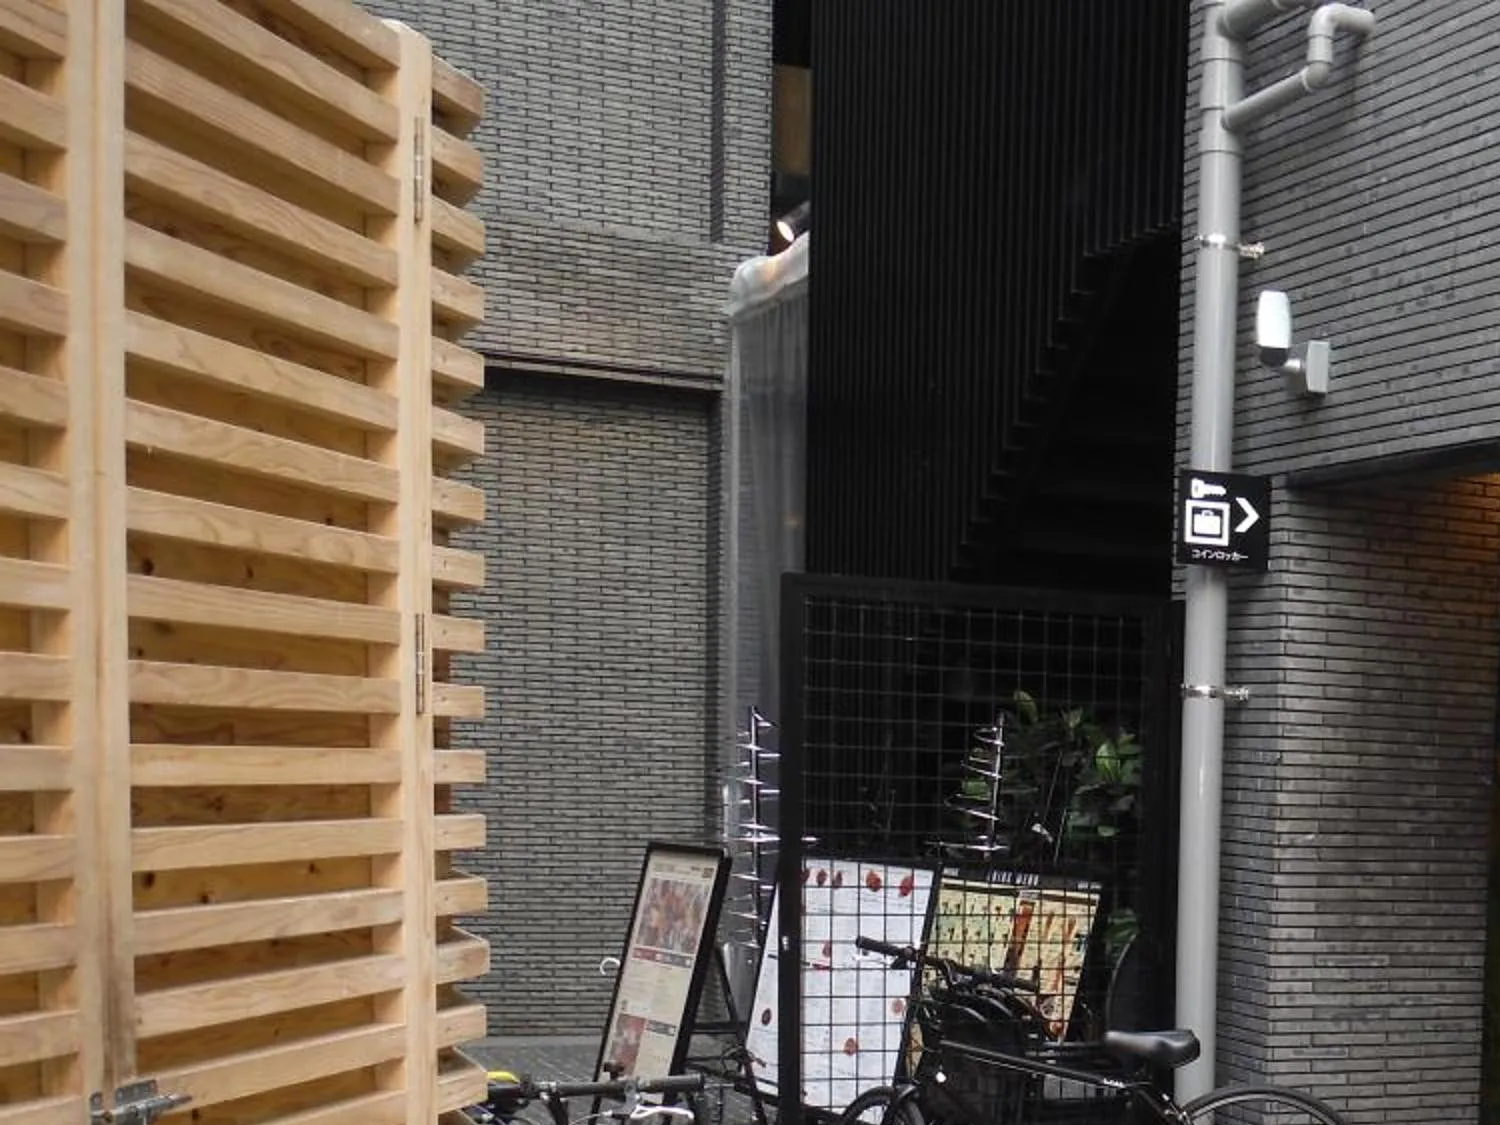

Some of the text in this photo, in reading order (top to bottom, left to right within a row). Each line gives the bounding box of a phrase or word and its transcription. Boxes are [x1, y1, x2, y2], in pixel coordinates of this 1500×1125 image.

[1191, 549, 1249, 561] コインロッカー
